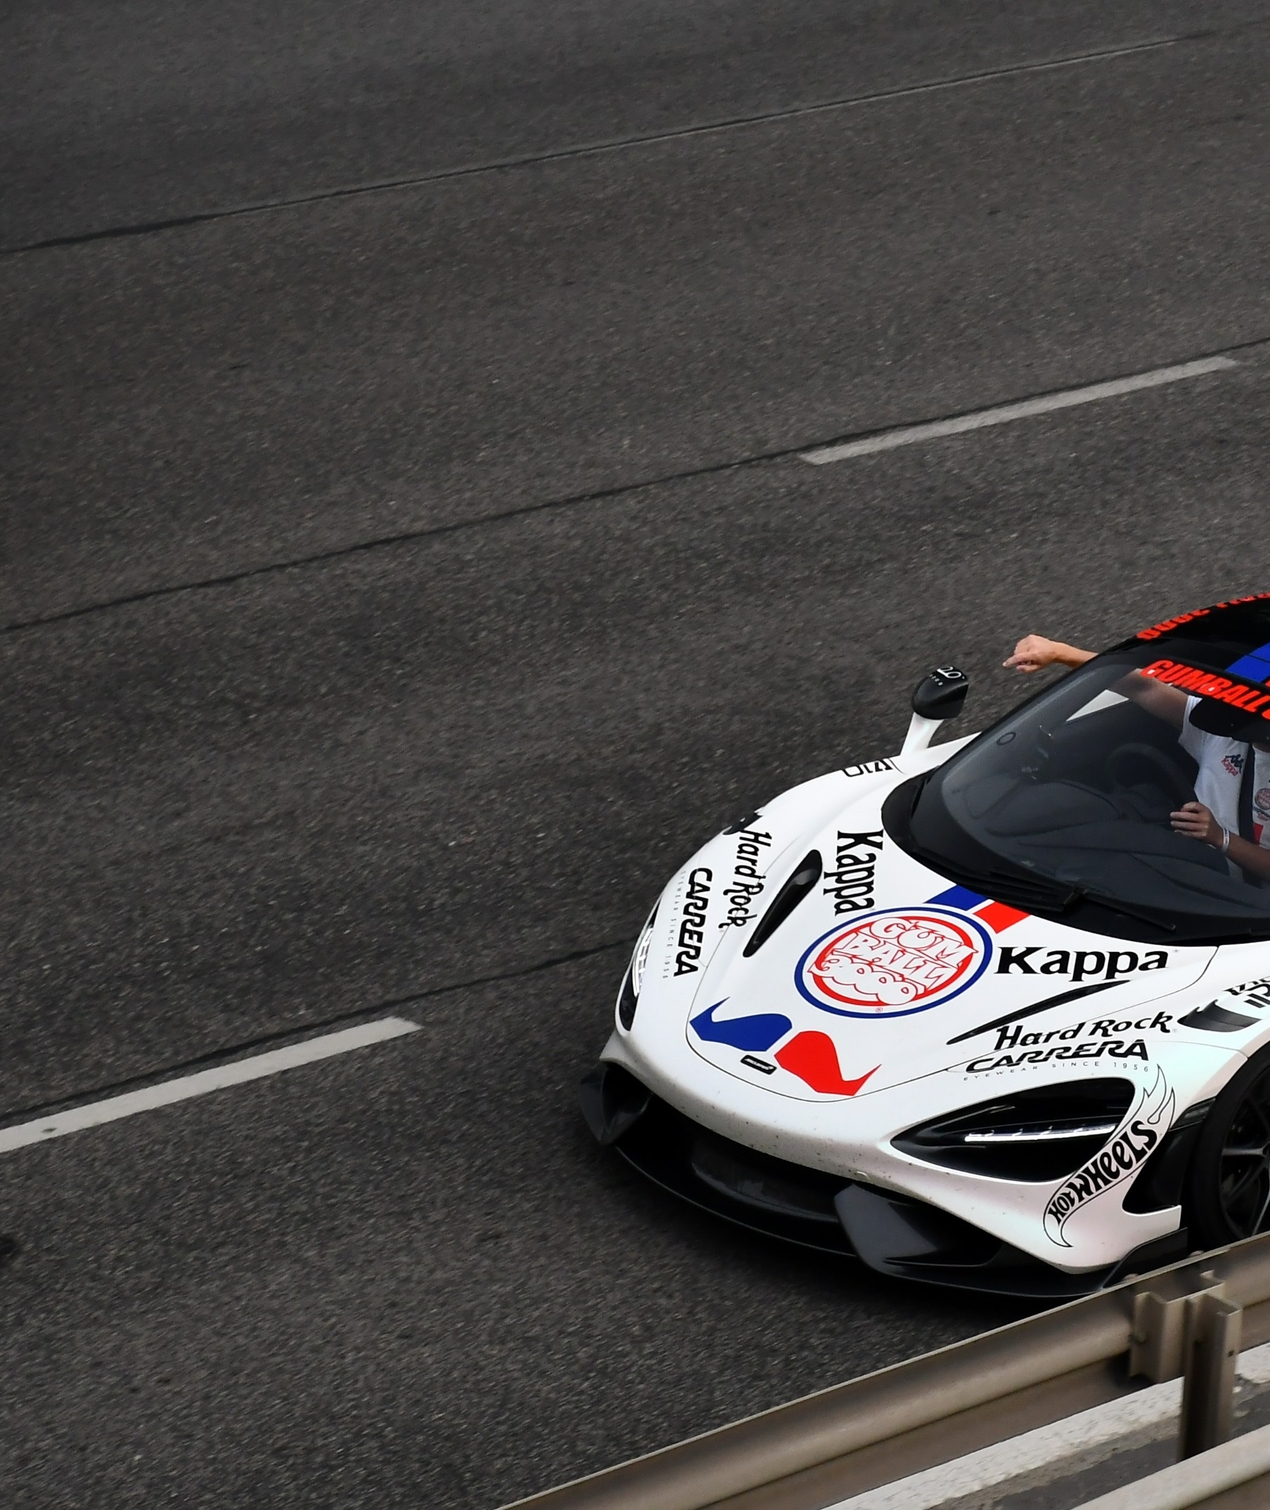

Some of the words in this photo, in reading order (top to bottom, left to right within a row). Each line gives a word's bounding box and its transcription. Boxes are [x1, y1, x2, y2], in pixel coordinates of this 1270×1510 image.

[734, 829, 773, 879] Hard
[823, 829, 885, 916] Kappa
[673, 867, 713, 977] CARRERA
[718, 880, 765, 929] Rock
[993, 945, 1170, 982] Kappa
[994, 1025, 1087, 1050] Hard
[1088, 1011, 1174, 1037] Rock
[964, 1065, 1038, 1081] EYEWEAR
[1113, 1062, 1149, 1073] 1956
[966, 1039, 1149, 1073] CARRERA
[1047, 1191, 1076, 1226] HOT
